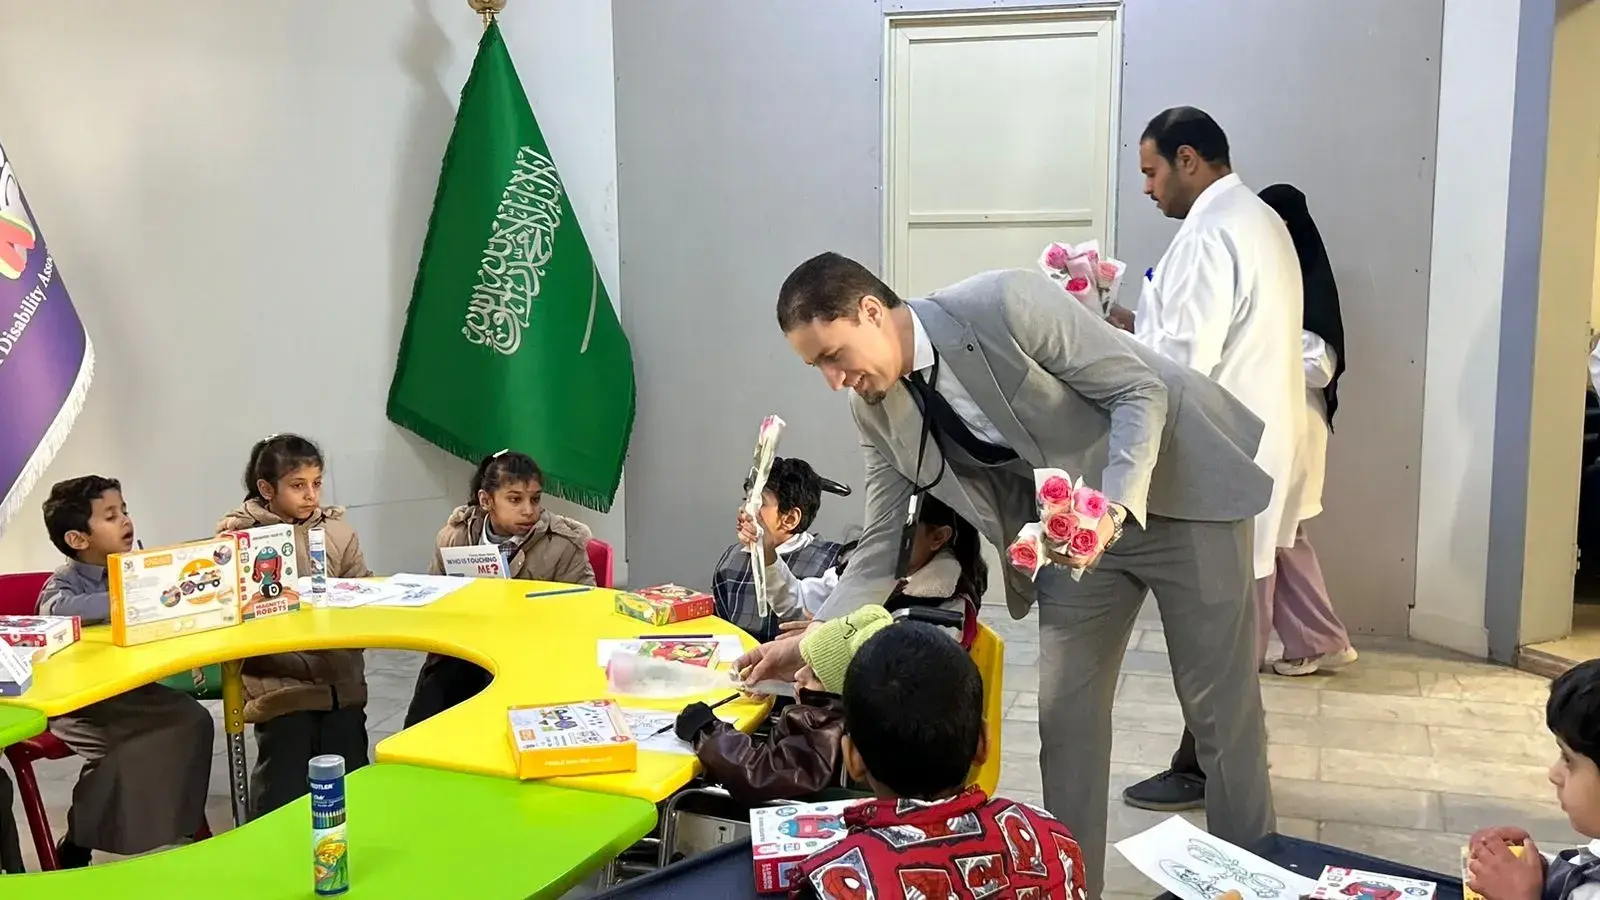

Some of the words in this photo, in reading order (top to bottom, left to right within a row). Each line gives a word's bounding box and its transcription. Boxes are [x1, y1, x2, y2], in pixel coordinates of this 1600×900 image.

[0, 285, 47, 355] Disability
[467, 556, 497, 564] TOUCHING
[477, 563, 499, 575] ME?
[256, 605, 287, 616] ROBOTS
